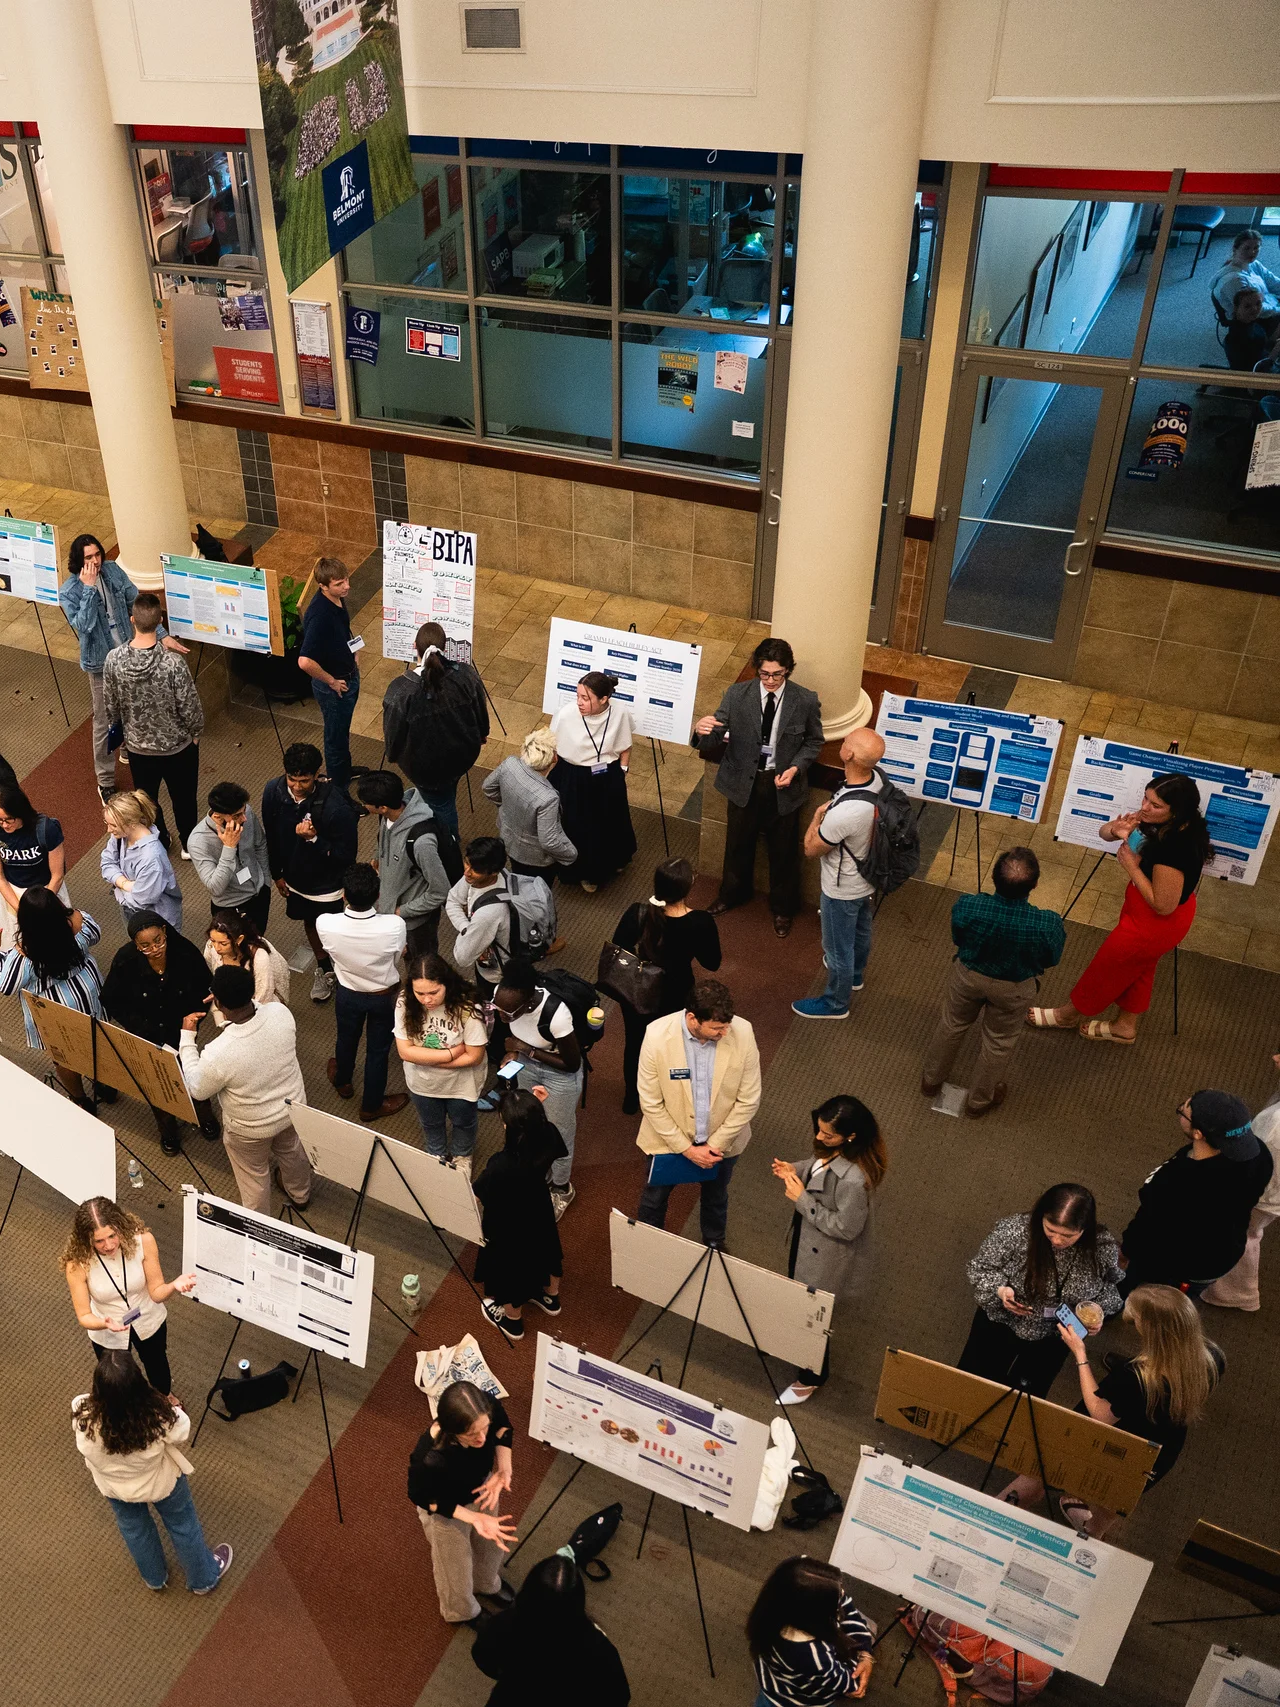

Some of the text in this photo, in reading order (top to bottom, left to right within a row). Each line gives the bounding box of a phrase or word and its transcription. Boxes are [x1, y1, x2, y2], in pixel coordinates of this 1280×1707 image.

[332, 189, 365, 220] BELMONT
[336, 203, 363, 226] UNIVERSITY
[491, 248, 510, 271] SAPB
[30, 289, 65, 303] WHAT
[231, 358, 263, 368] STUDENTS
[665, 361, 692, 370] ROBOT
[677, 355, 698, 364] WILD
[235, 366, 262, 375] SERVING
[234, 373, 266, 383] STUDENTS
[1149, 418, 1188, 435] 1000
[1248, 450, 1259, 474] SPRING
[1128, 470, 1157, 478] CONFERENCE
[432, 531, 474, 566] BIPA
[939, 703, 959, 711] Academic
[977, 709, 1000, 717] Preserving
[951, 722, 984, 733] Implementation
[1017, 733, 1041, 744] Discussion
[1090, 759, 1119, 770] Background
[1141, 753, 1162, 762] Changer:
[1162, 756, 1188, 768] Visualizing
[1188, 762, 1203, 770] Player
[1203, 765, 1225, 776] Progress
[1088, 790, 1102, 799] Goals
[1229, 787, 1256, 799] Discussion
[0, 845, 42, 861] SPARK
[909, 1478, 956, 1500] Development
[963, 1501, 990, 1515] Cloning
[990, 1512, 1037, 1534] Confirmation
[1037, 1532, 1067, 1546] Method
